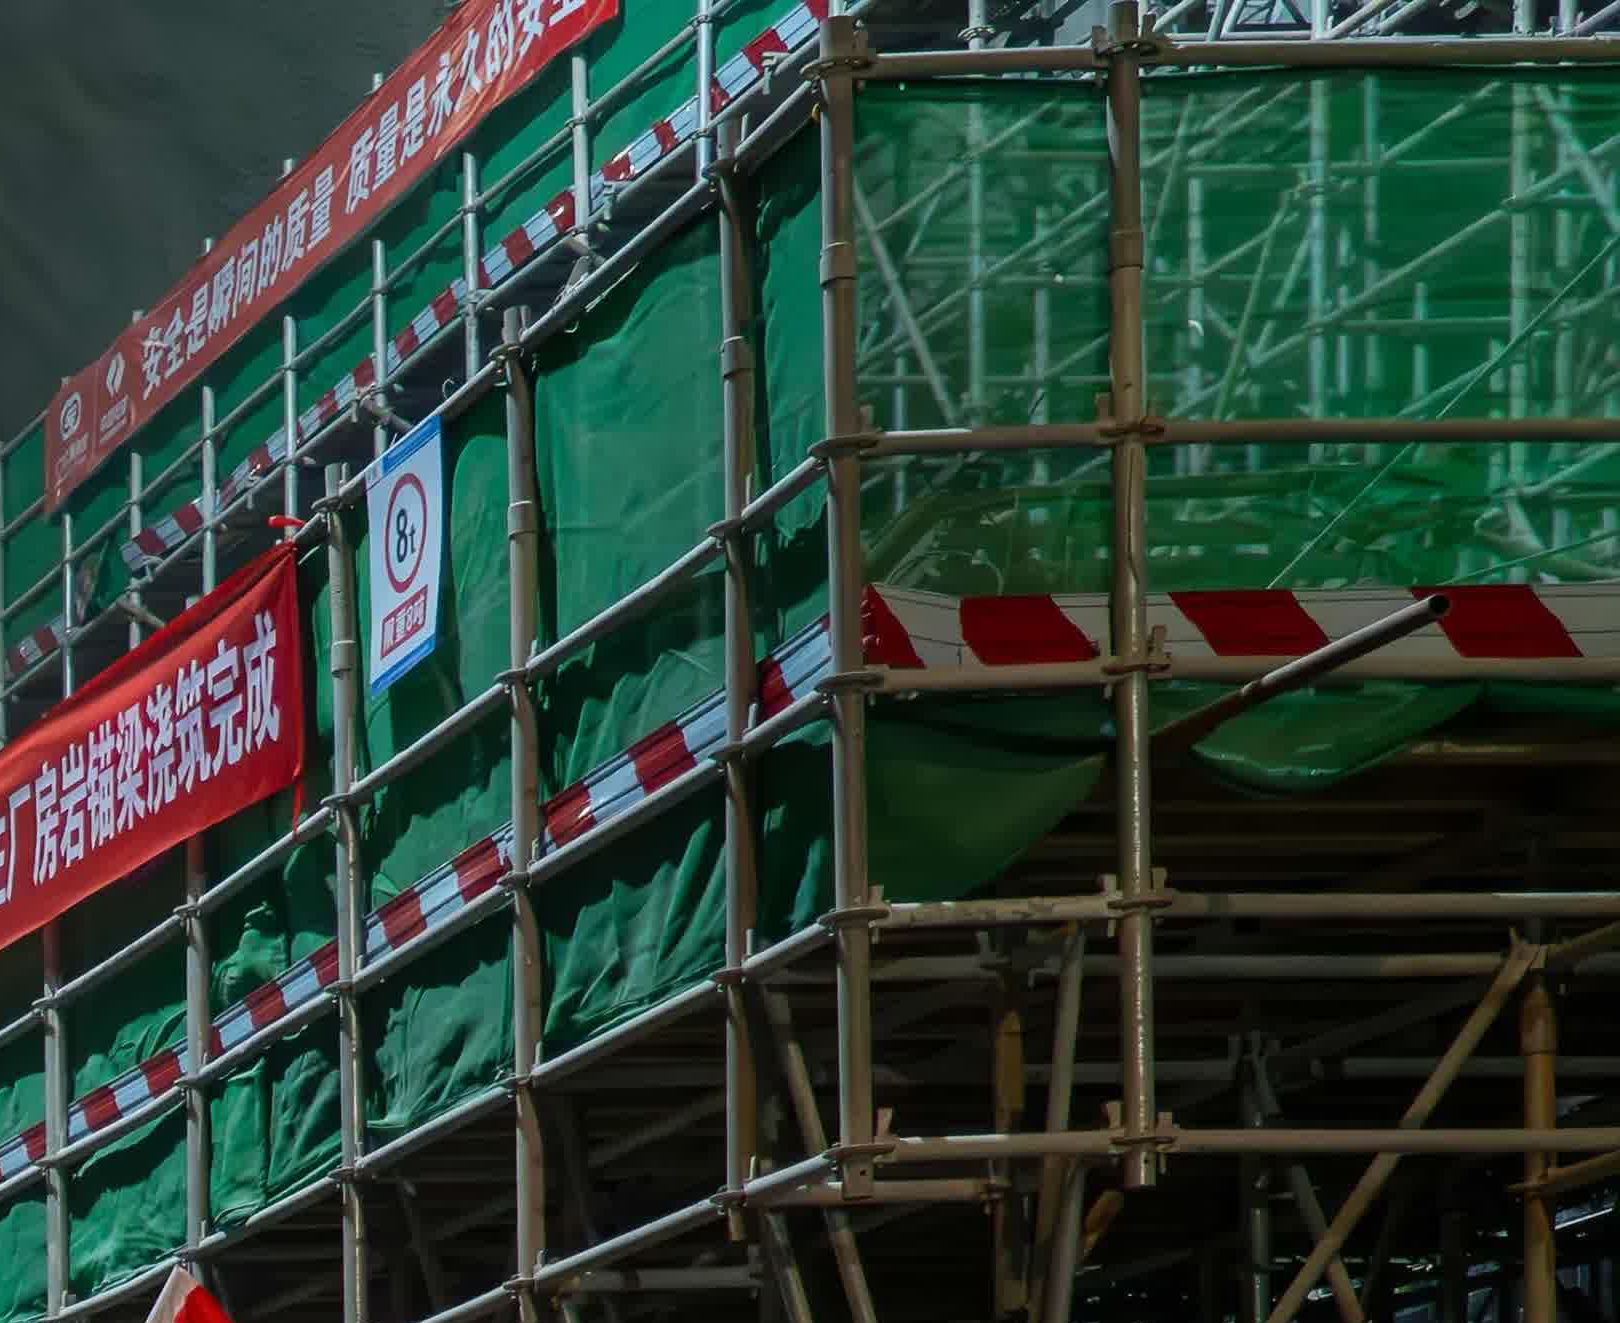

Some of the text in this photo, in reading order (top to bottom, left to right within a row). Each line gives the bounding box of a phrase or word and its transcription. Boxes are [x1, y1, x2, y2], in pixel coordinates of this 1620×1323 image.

[141, 166, 336, 402] 安全是瞬间的质量
[395, 507, 417, 564] 8t
